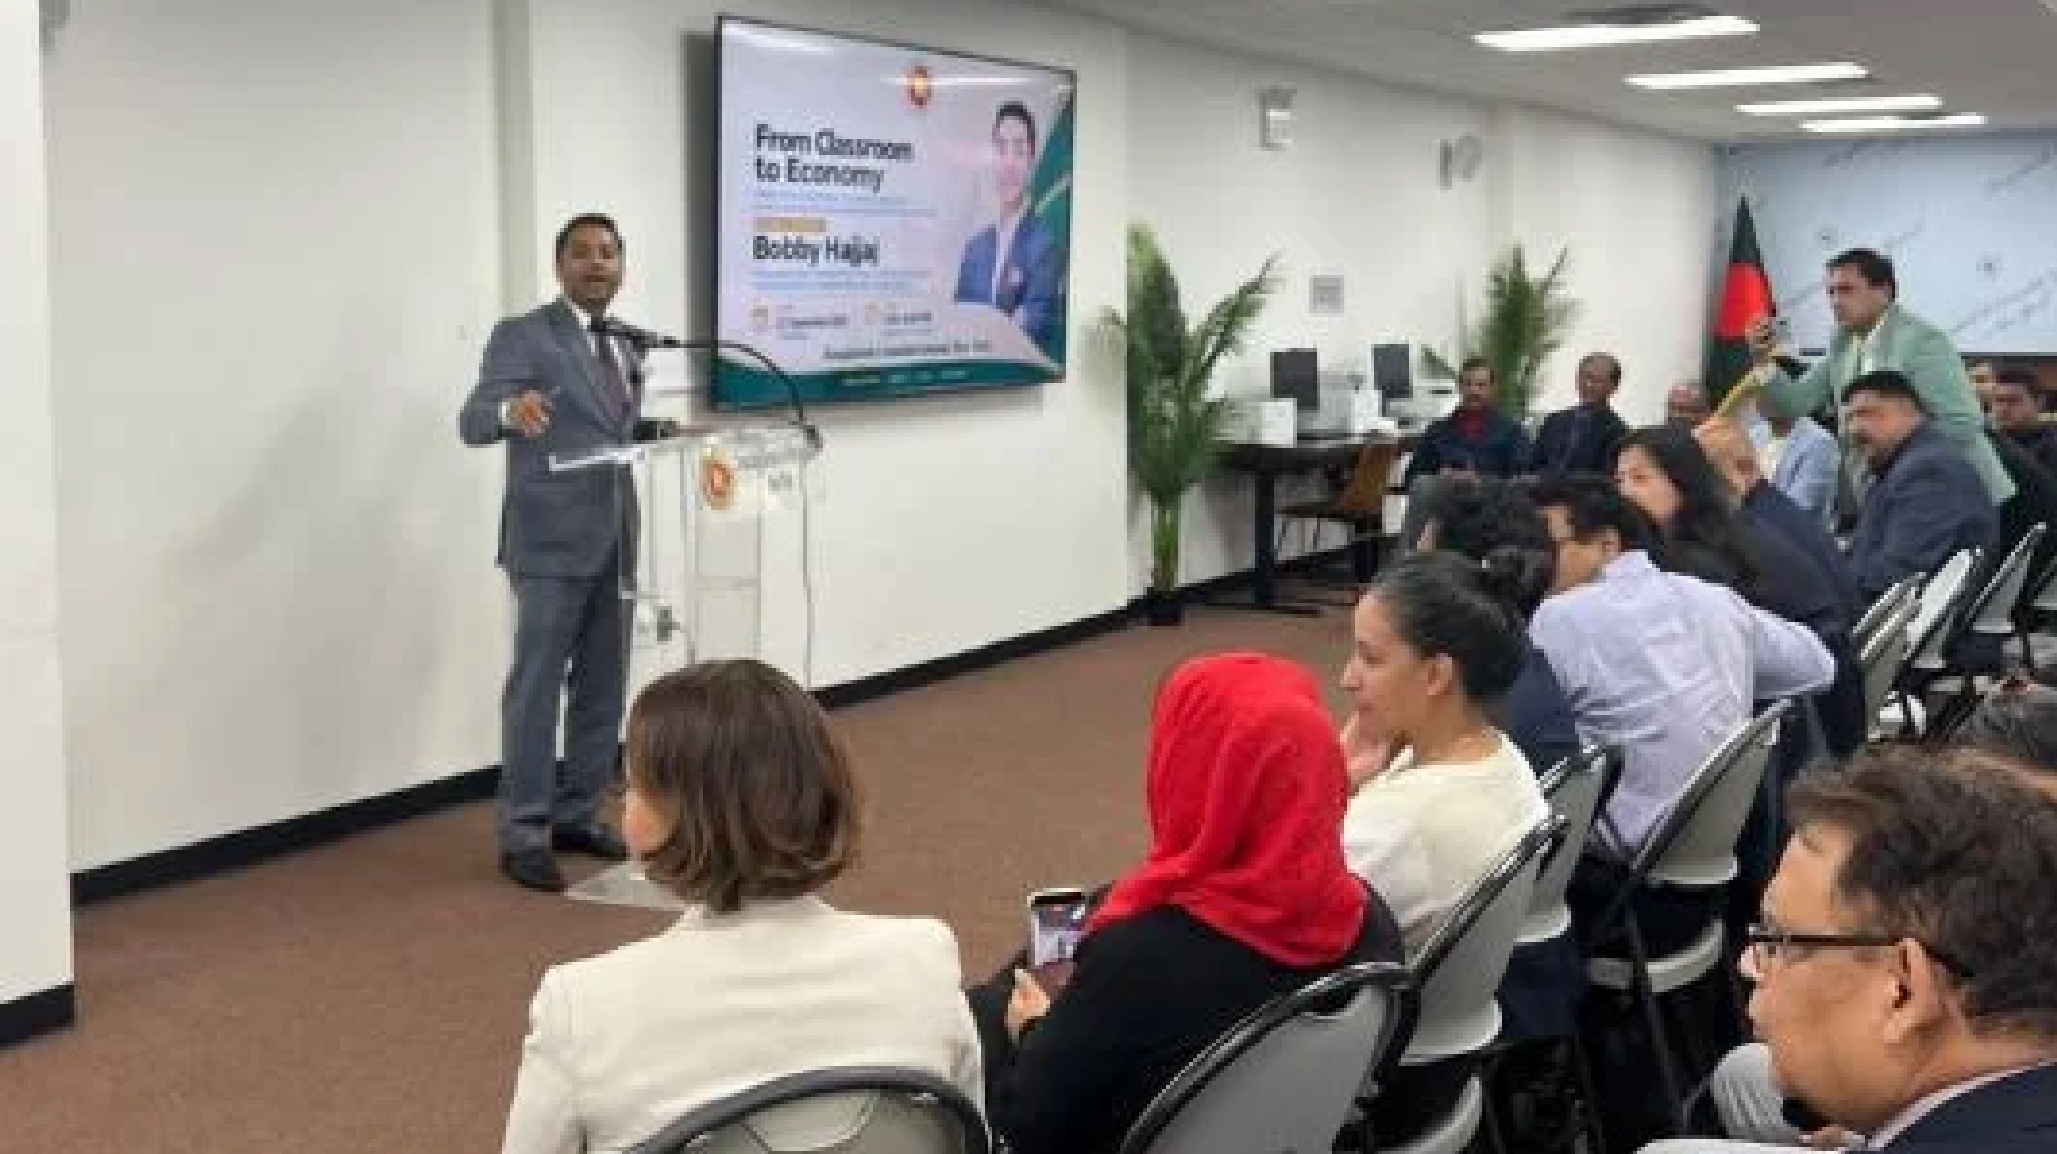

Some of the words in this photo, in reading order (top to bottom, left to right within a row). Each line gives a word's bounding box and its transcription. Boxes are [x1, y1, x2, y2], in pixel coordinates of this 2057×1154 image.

[756, 123, 811, 154] From
[815, 128, 914, 162] Classroom
[756, 158, 780, 182] to
[786, 158, 884, 192] Economy
[753, 235, 819, 267] Bobby
[825, 235, 880, 267] Hajjaj
